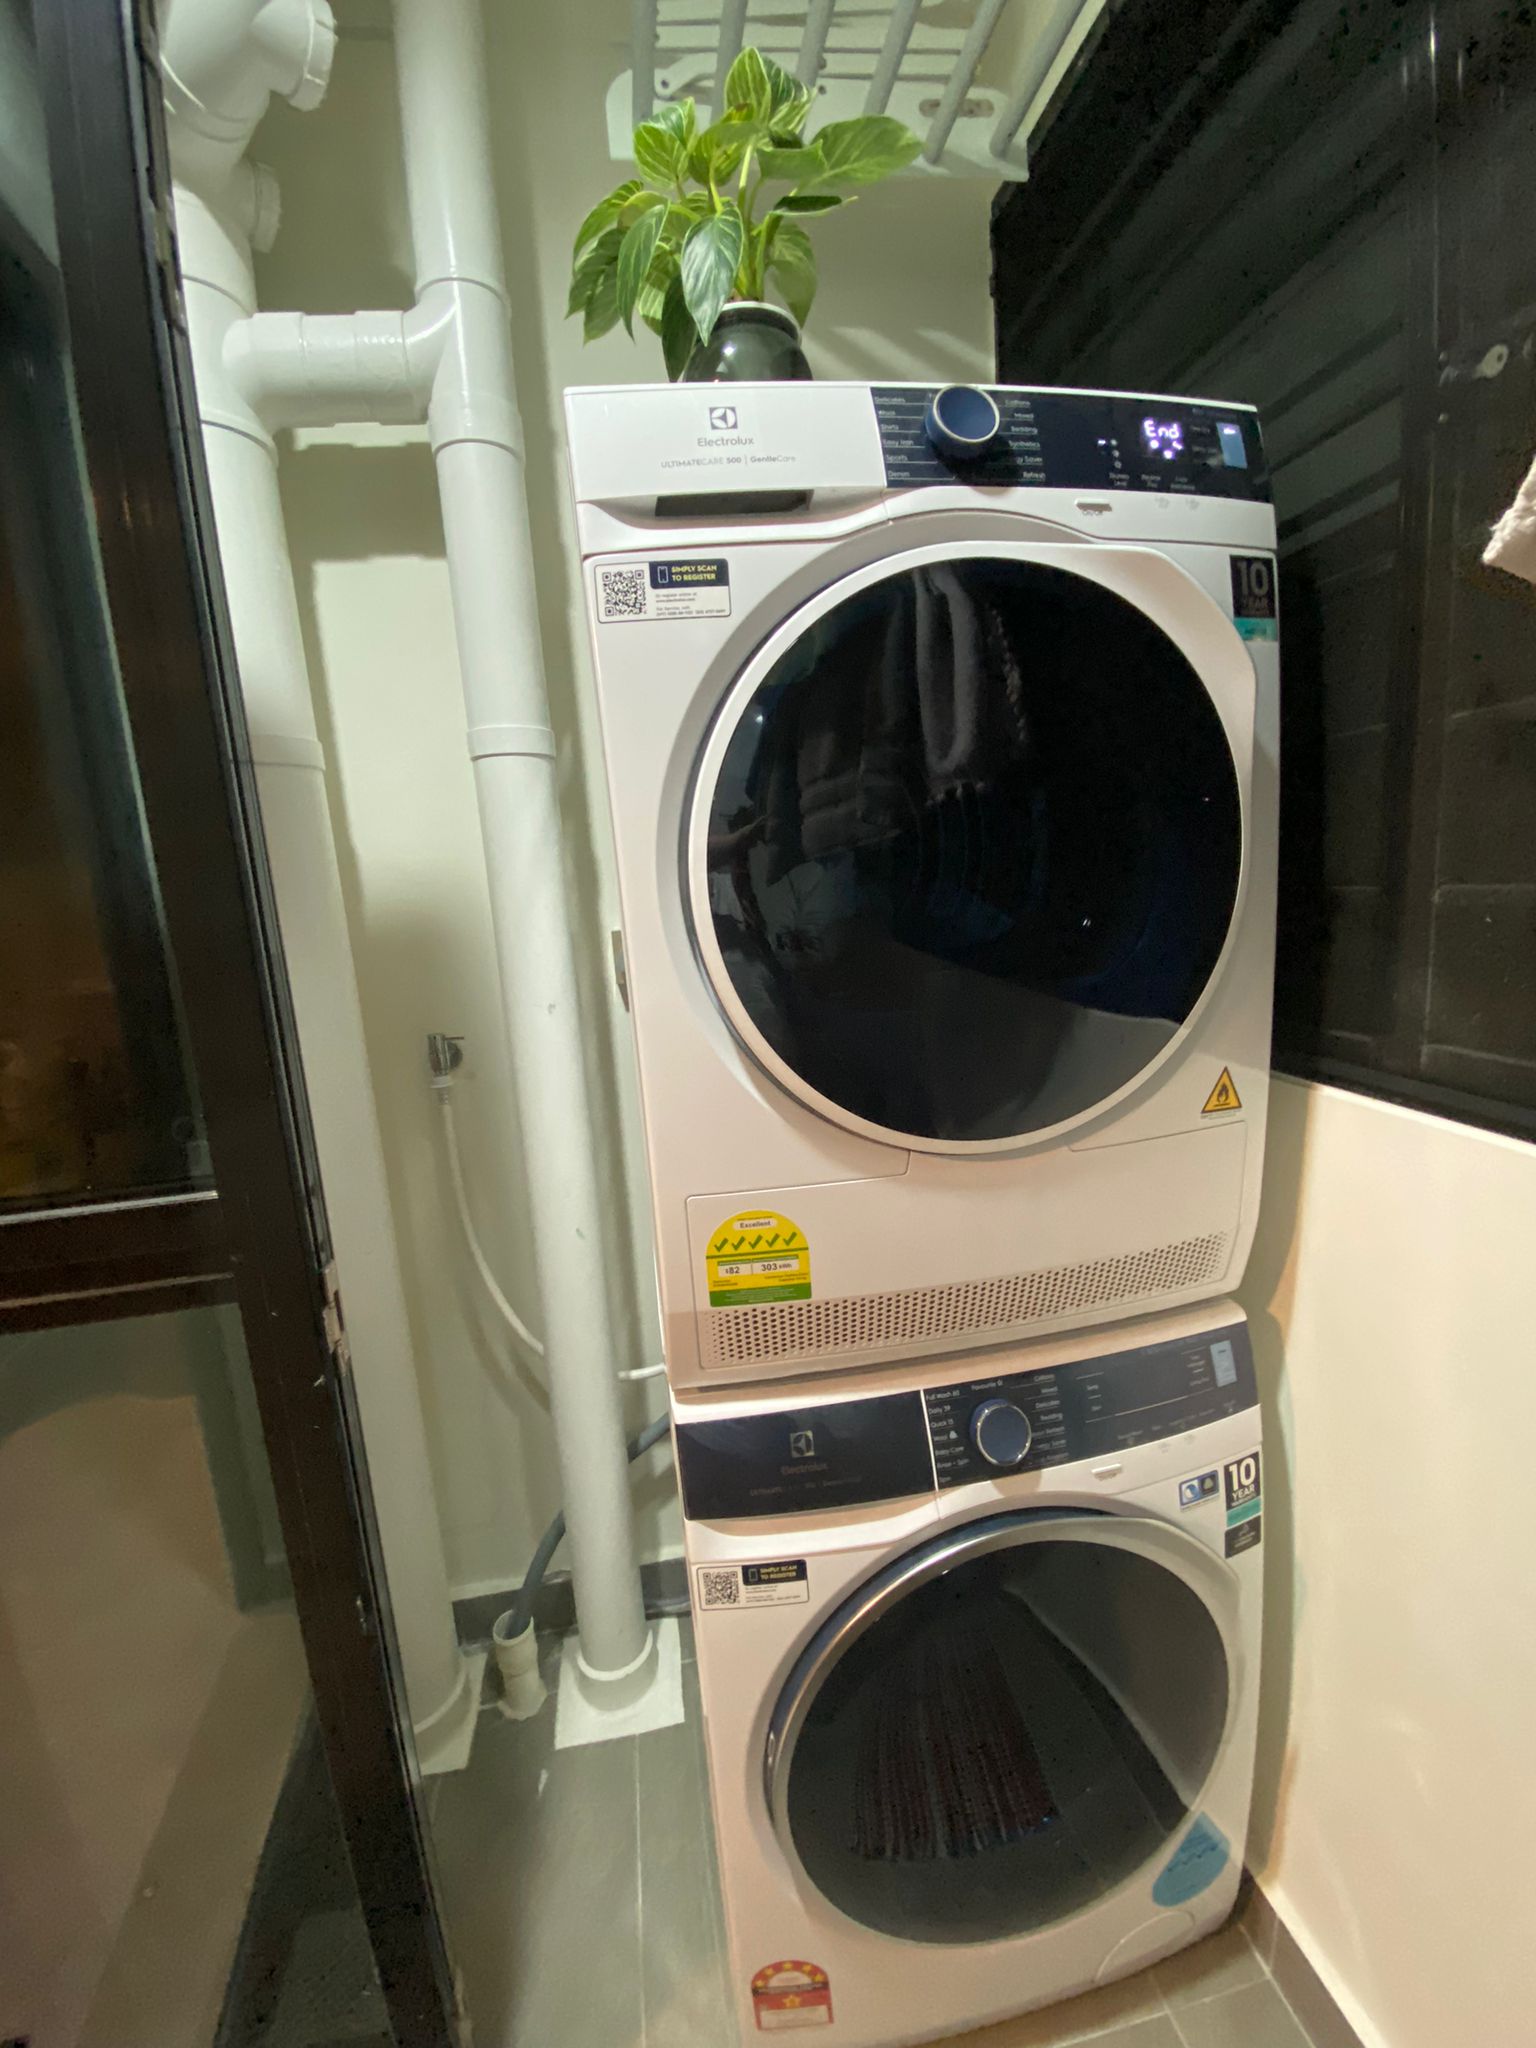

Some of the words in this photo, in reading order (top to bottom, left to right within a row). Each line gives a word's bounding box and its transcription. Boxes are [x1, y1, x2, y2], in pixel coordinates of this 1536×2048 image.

[1143, 418, 1181, 439] End
[697, 436, 755, 447] Electrolux
[661, 457, 723, 468] ULTIMATECARE
[750, 455, 797, 463] GentleCare
[672, 574, 682, 582] TO
[683, 573, 716, 581] REGISTER
[1237, 561, 1269, 596] 10
[740, 1220, 771, 1229] Excellent
[761, 1263, 778, 1271] 303
[1229, 1457, 1256, 1491] 10
[1232, 1484, 1256, 1501] YEAR
